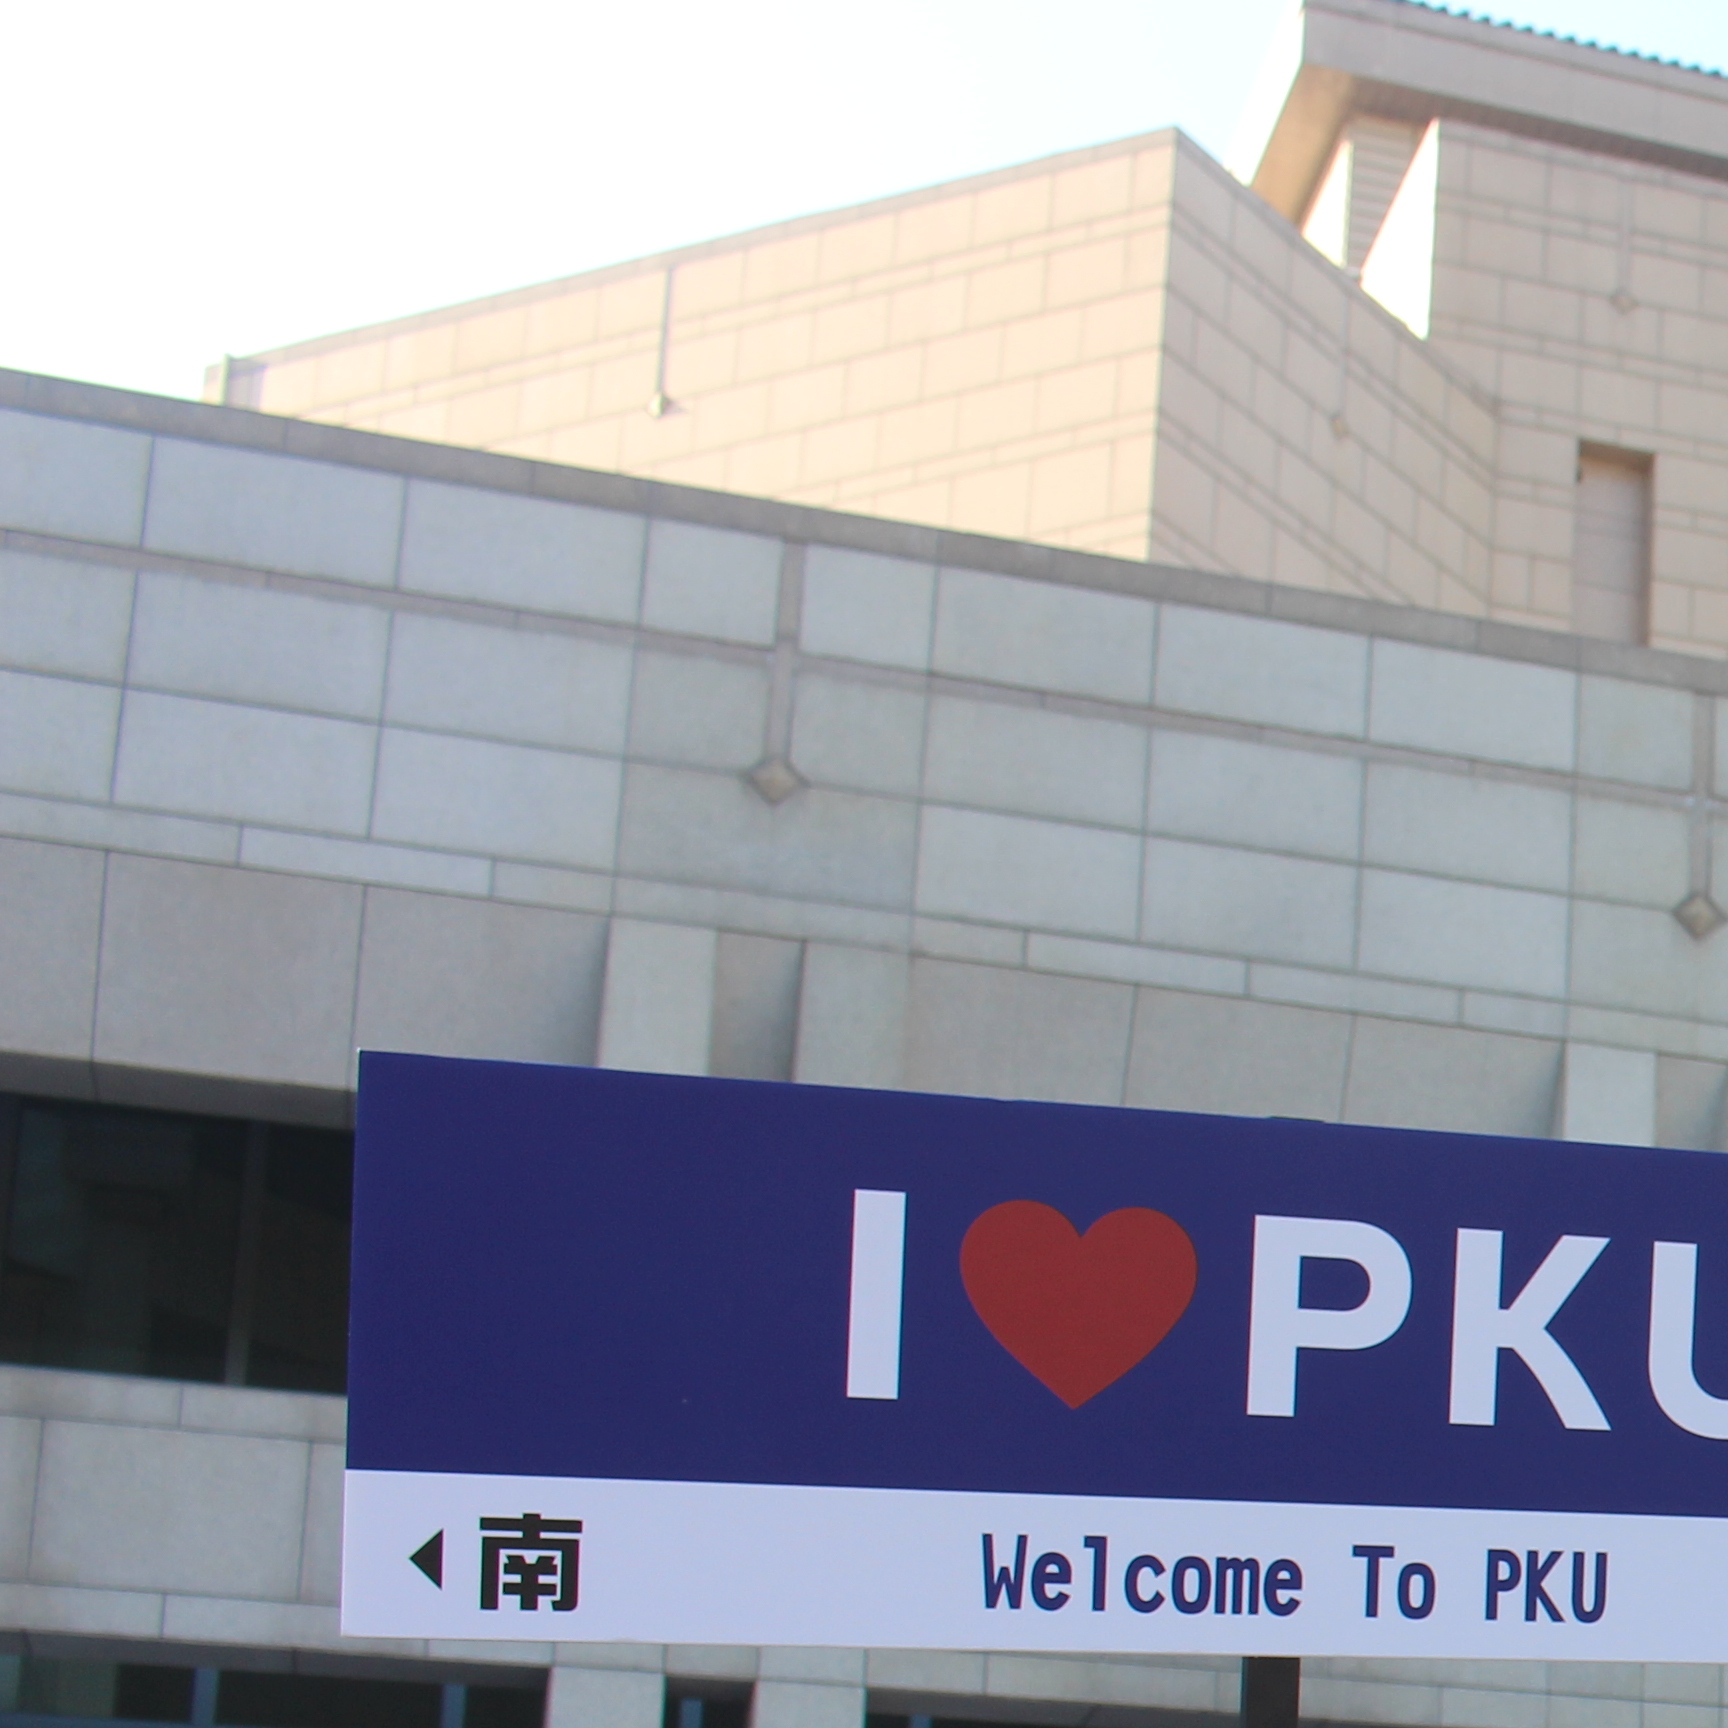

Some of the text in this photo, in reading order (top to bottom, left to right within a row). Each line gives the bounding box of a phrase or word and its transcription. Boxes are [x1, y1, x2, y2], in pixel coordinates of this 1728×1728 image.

[847, 1190, 906, 1400] I
[480, 1512, 583, 1612] 南
[981, 1532, 1608, 1625] Welcome To PKU
